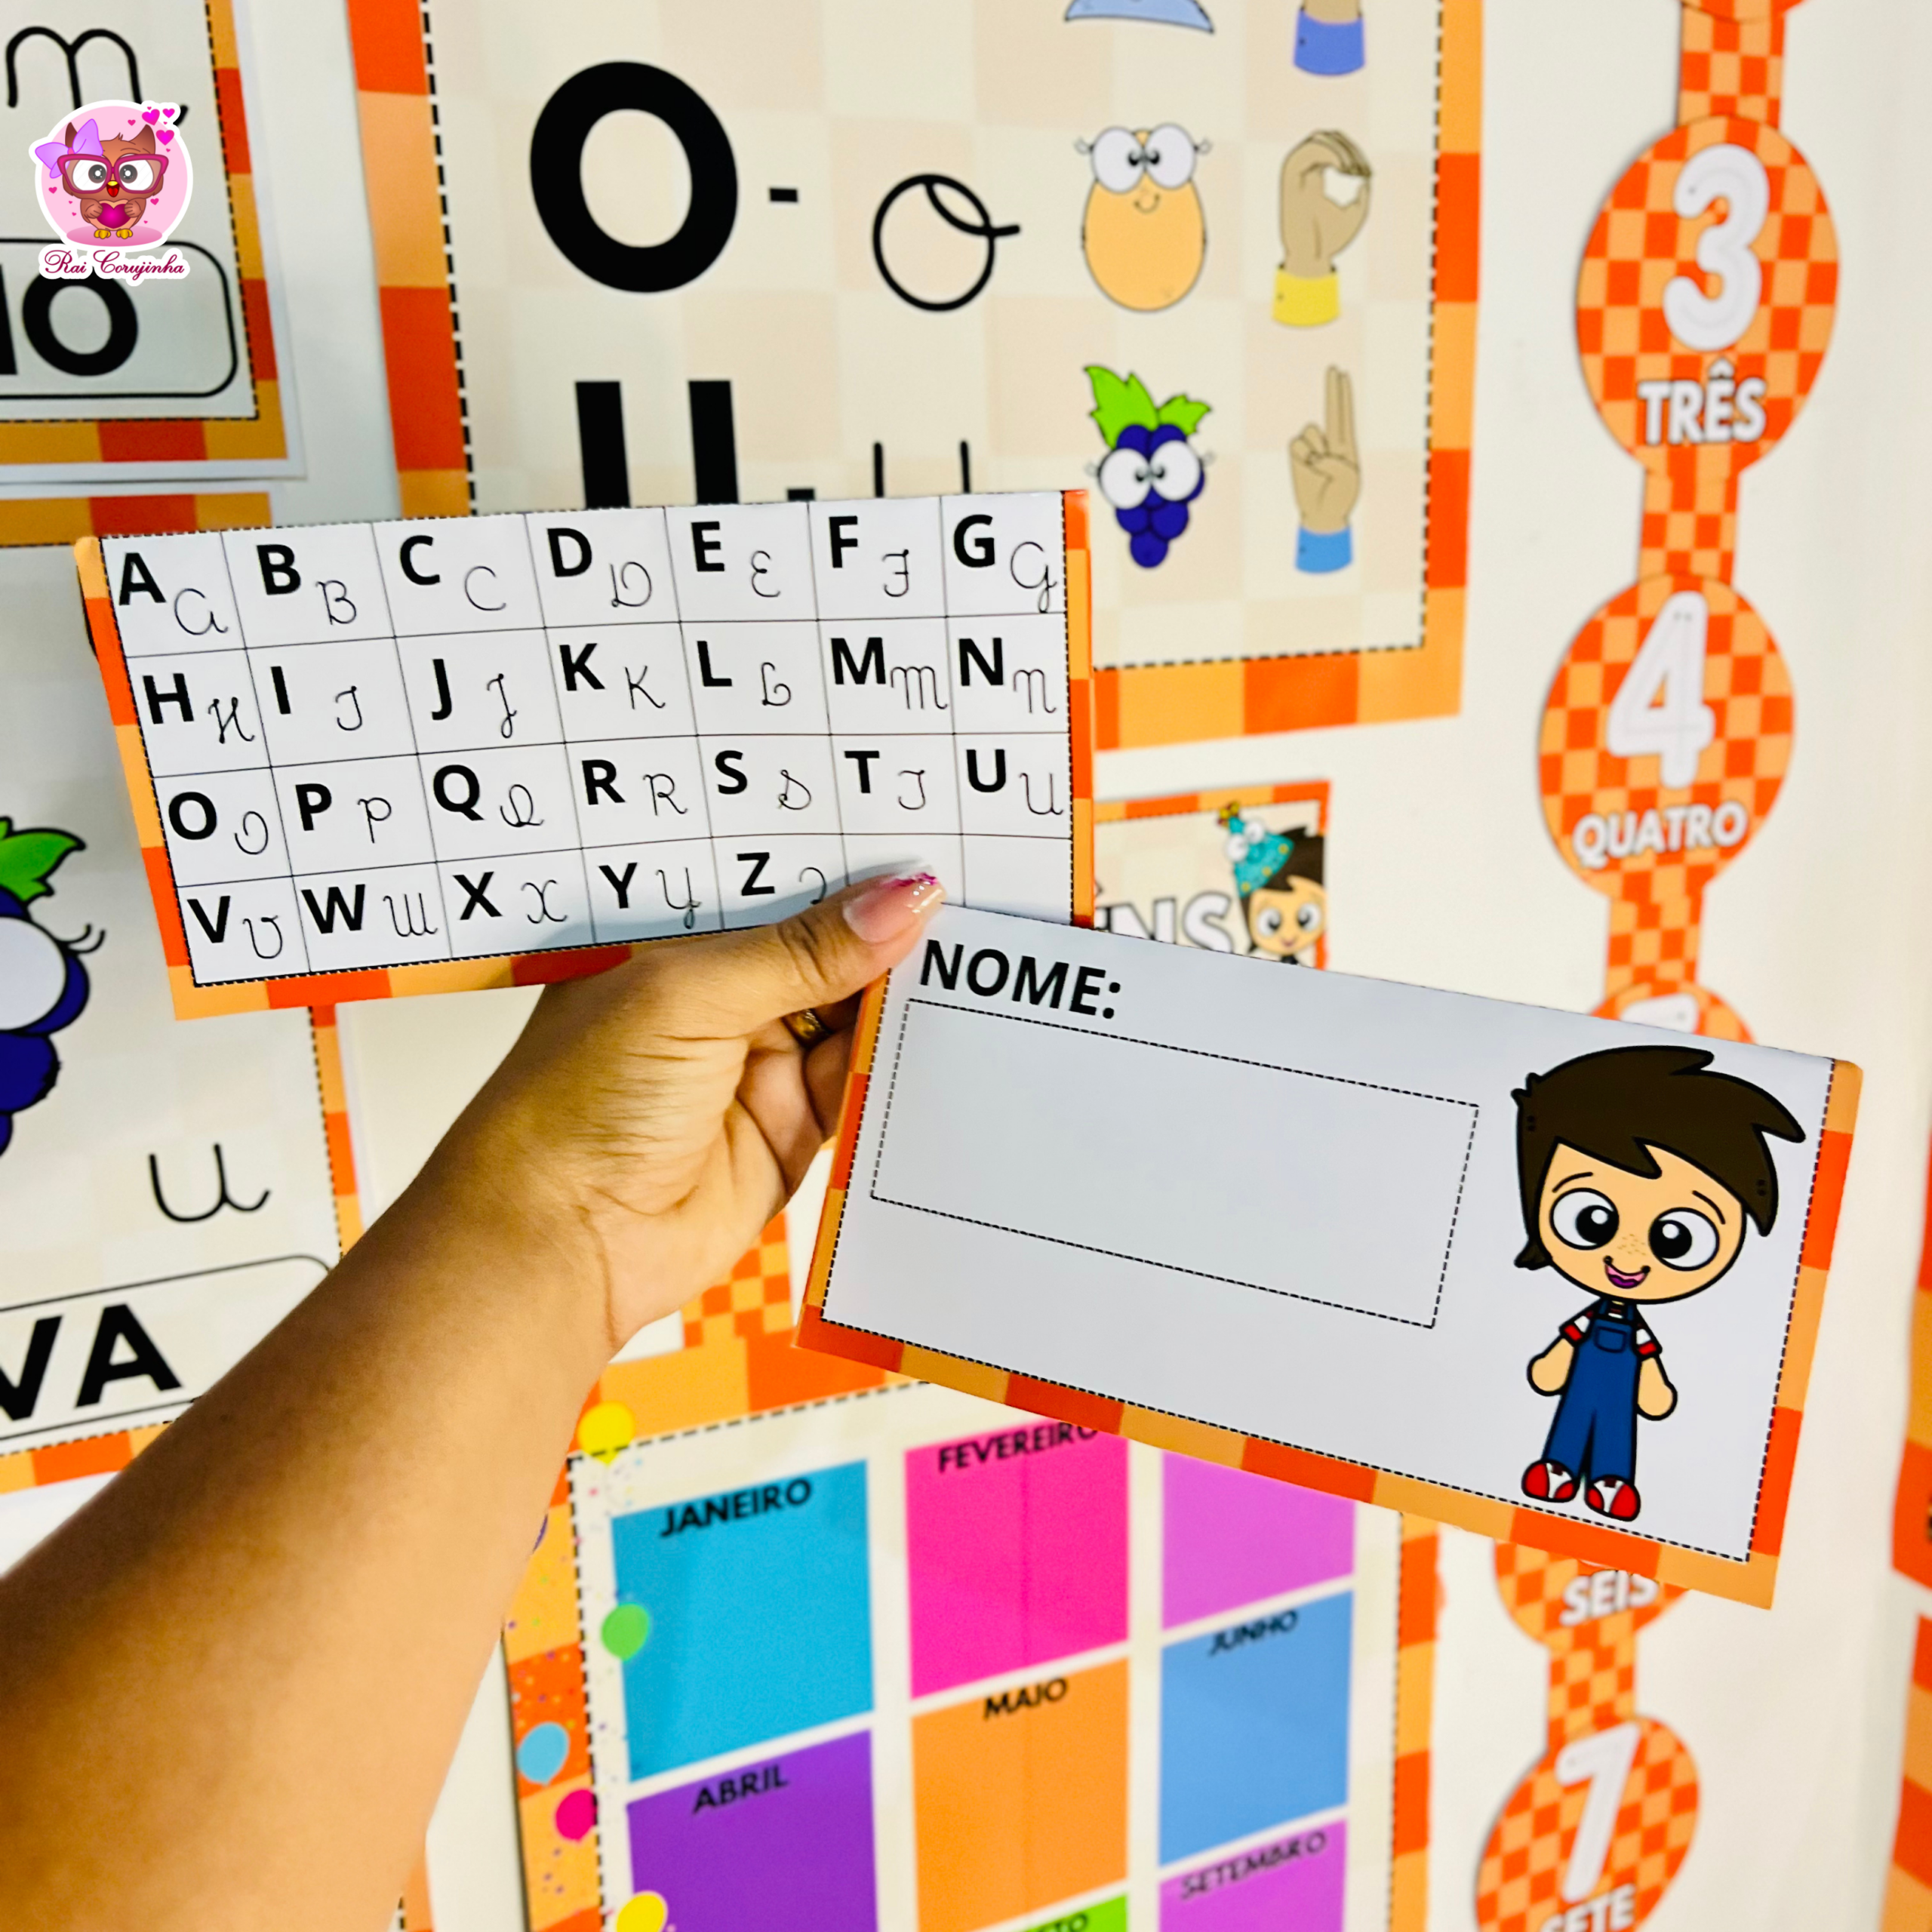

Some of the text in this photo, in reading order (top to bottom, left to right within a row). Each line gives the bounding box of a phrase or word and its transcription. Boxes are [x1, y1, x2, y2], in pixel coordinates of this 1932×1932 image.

[530, 61, 738, 293] O
[1663, 143, 1769, 352] 3
[1638, 356, 1767, 445] TRÊS
[399, 534, 441, 586] C
[546, 527, 592, 578] D
[690, 521, 725, 573] E
[828, 515, 859, 569] F
[953, 514, 995, 568] G
[118, 552, 167, 606] A
[256, 543, 302, 596] B
[558, 642, 606, 692] K
[696, 640, 733, 688] L
[830, 636, 887, 685] M
[958, 637, 1004, 687] N
[143, 672, 195, 724] H
[270, 666, 291, 715] I
[431, 658, 453, 721] J
[1606, 591, 1715, 789] 4
[432, 764, 485, 822] Q
[581, 758, 626, 806] R
[714, 749, 748, 795] S
[844, 750, 881, 794] T
[965, 749, 1007, 793] U
[168, 791, 218, 841] O
[294, 783, 333, 832] P
[1572, 801, 1749, 869] QUATRO
[452, 871, 503, 921] X
[598, 862, 638, 909] Y
[736, 851, 776, 897] Z
[187, 895, 232, 943] V
[301, 883, 367, 935] W
[920, 939, 1121, 1020] NOME:
[660, 1478, 814, 1538] JANEIRO
[984, 1677, 1068, 1719] MAIO
[692, 1764, 789, 1815] ABRIL
[1554, 1721, 1641, 1905] 7
